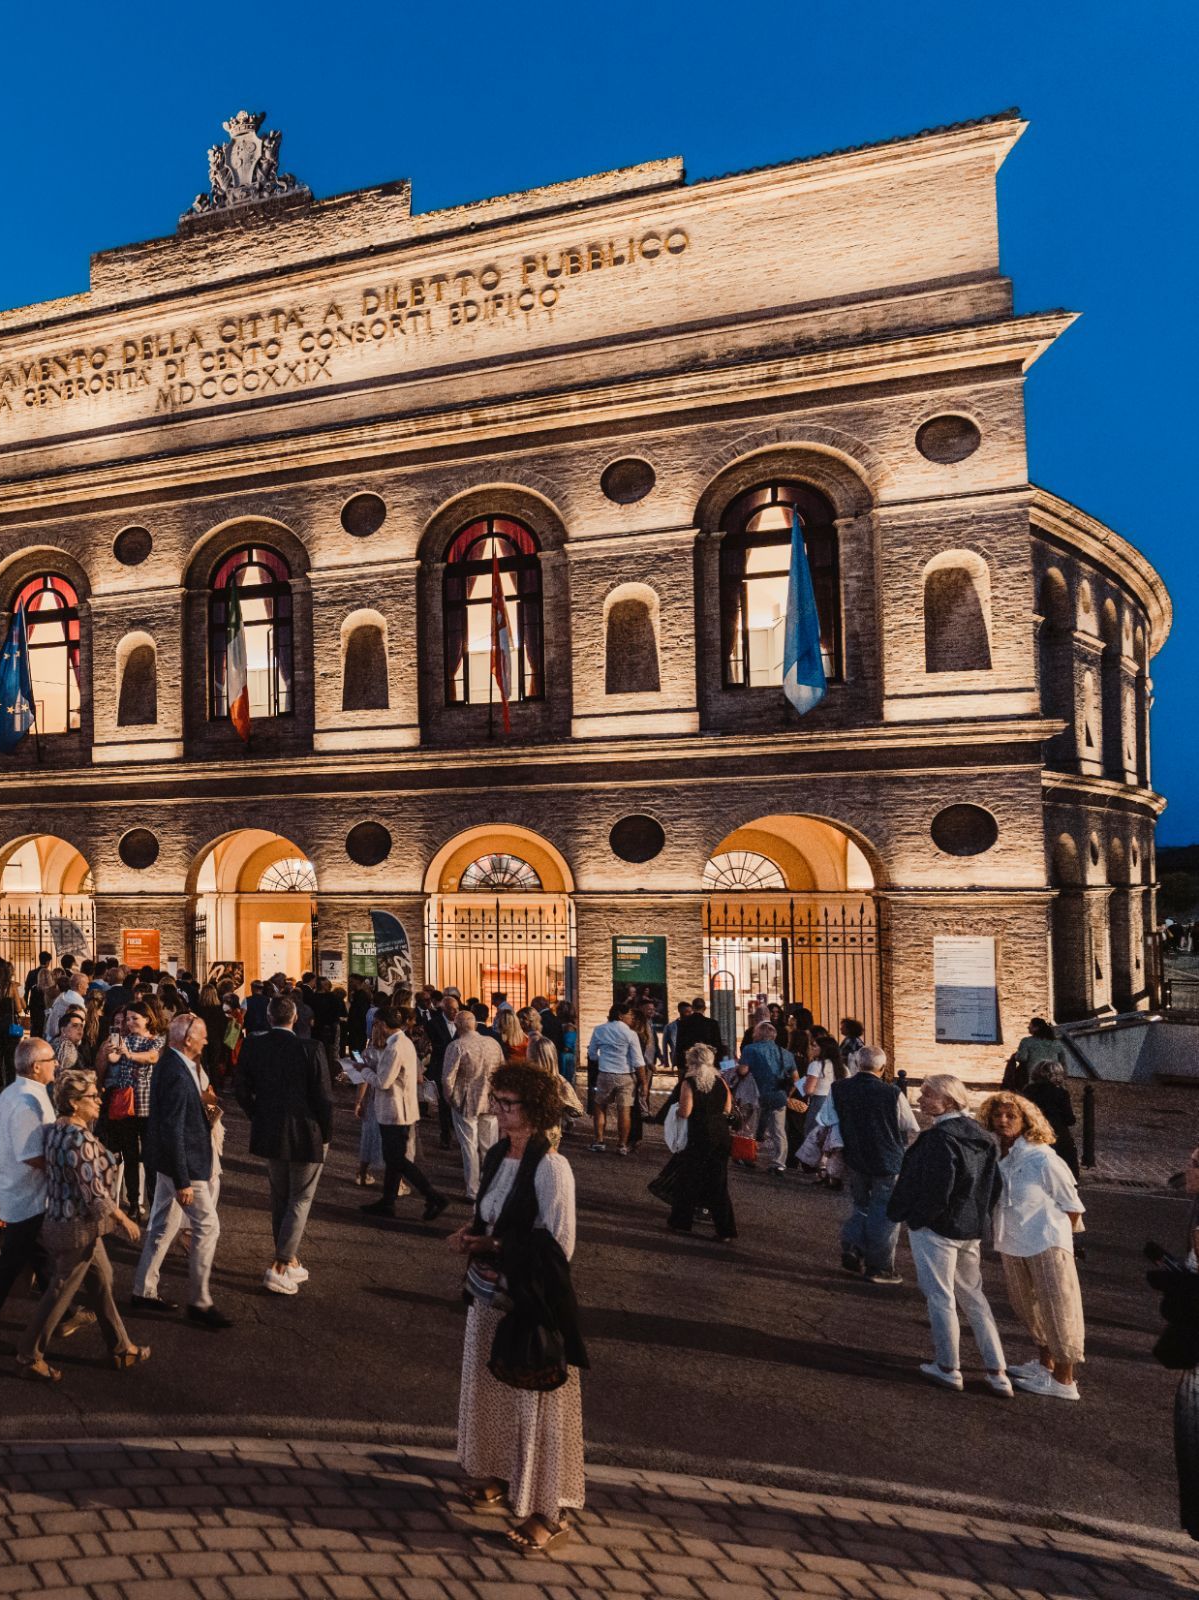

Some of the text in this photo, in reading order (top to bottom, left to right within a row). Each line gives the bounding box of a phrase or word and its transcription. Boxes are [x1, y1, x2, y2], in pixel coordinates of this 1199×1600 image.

[122, 329, 204, 367] DELLA
[323, 301, 344, 324] A
[362, 264, 500, 316] DILETTO
[522, 228, 690, 284] PUBBLICO
[154, 354, 333, 412] MDCCCXXIX
[164, 357, 186, 383] DI
[201, 338, 281, 372] CENTO
[299, 311, 432, 353] CONSORTI
